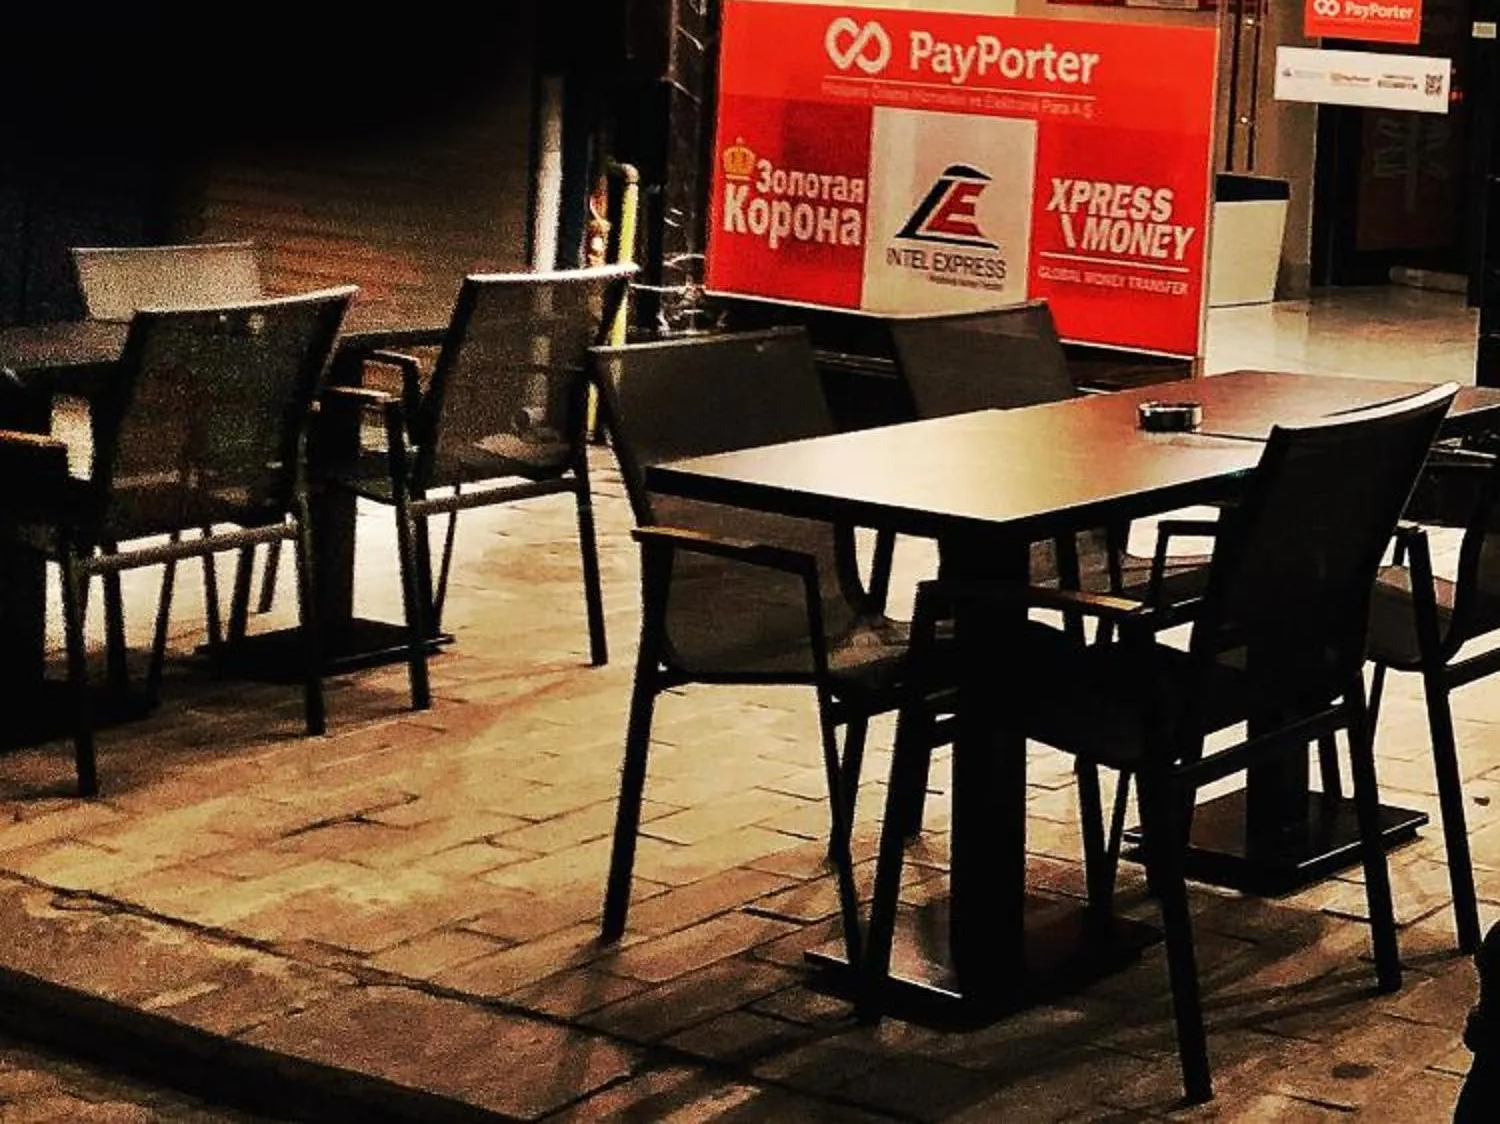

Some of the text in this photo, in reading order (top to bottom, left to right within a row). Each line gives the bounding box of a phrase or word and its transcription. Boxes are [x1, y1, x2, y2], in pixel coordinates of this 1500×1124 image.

[1343, 1, 1415, 22] PayPorter
[908, 30, 1100, 85] PayPorter
[756, 159, 865, 204] Золотая
[1046, 178, 1174, 222] XPRESS
[723, 184, 864, 250] Корона
[1081, 216, 1196, 261] MONEY
[886, 247, 1007, 280] INTEL EXPRESS
[1128, 276, 1190, 296] TRANSFER
